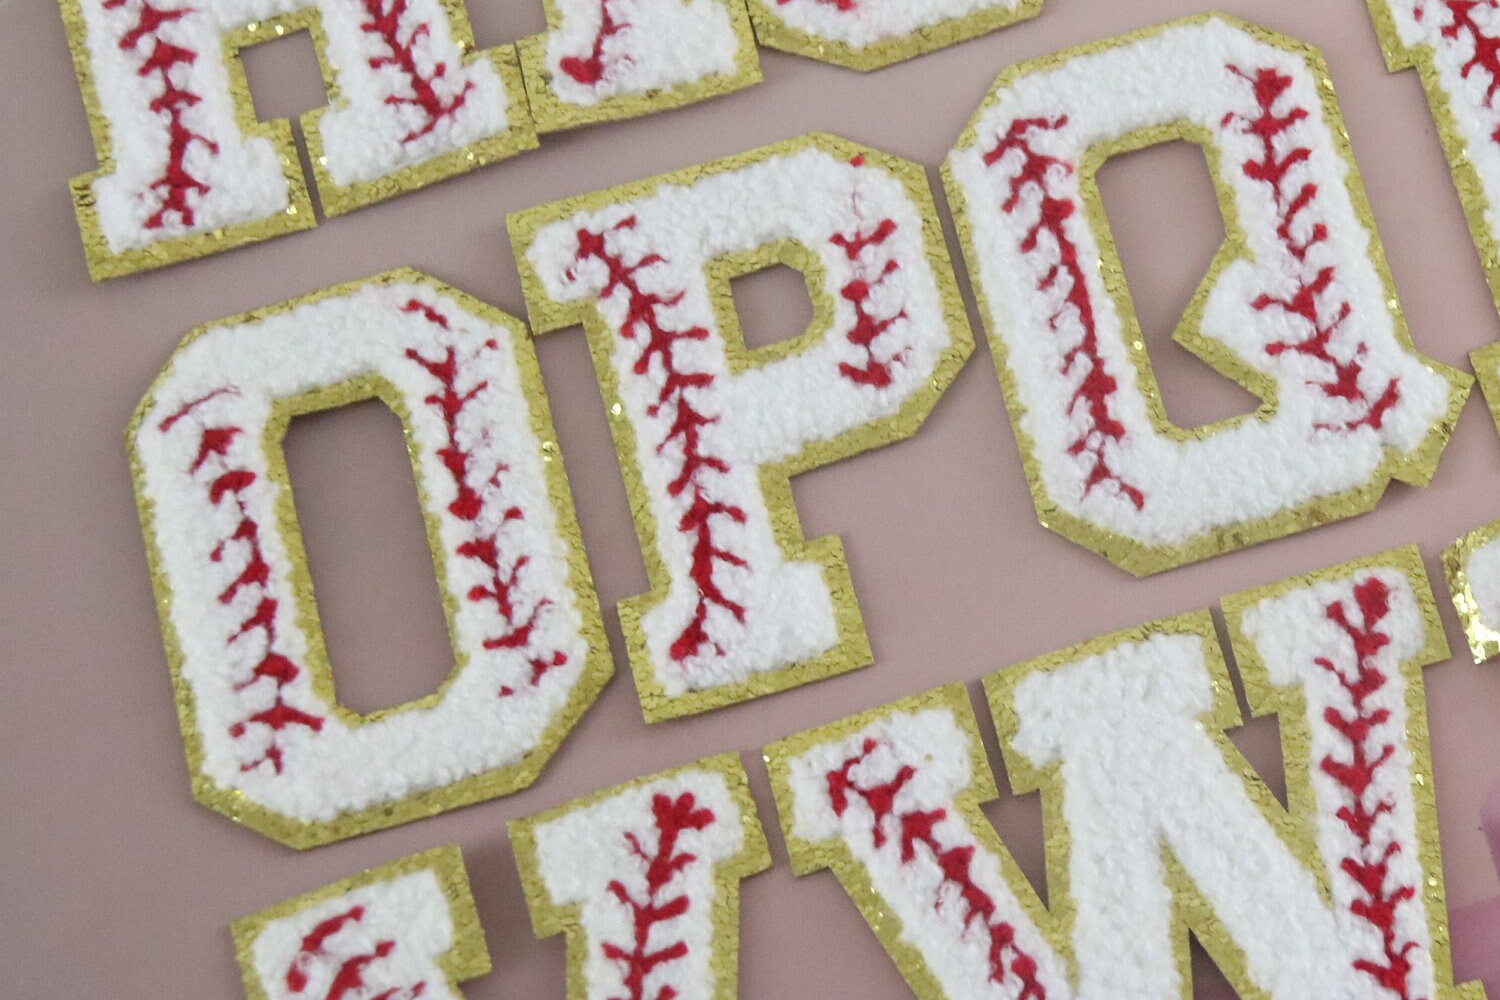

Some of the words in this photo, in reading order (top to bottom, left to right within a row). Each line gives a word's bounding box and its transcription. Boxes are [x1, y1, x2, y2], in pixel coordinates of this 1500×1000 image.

[125, 267, 614, 851] O
[506, 132, 975, 724] P
[940, 12, 1474, 578] Q
